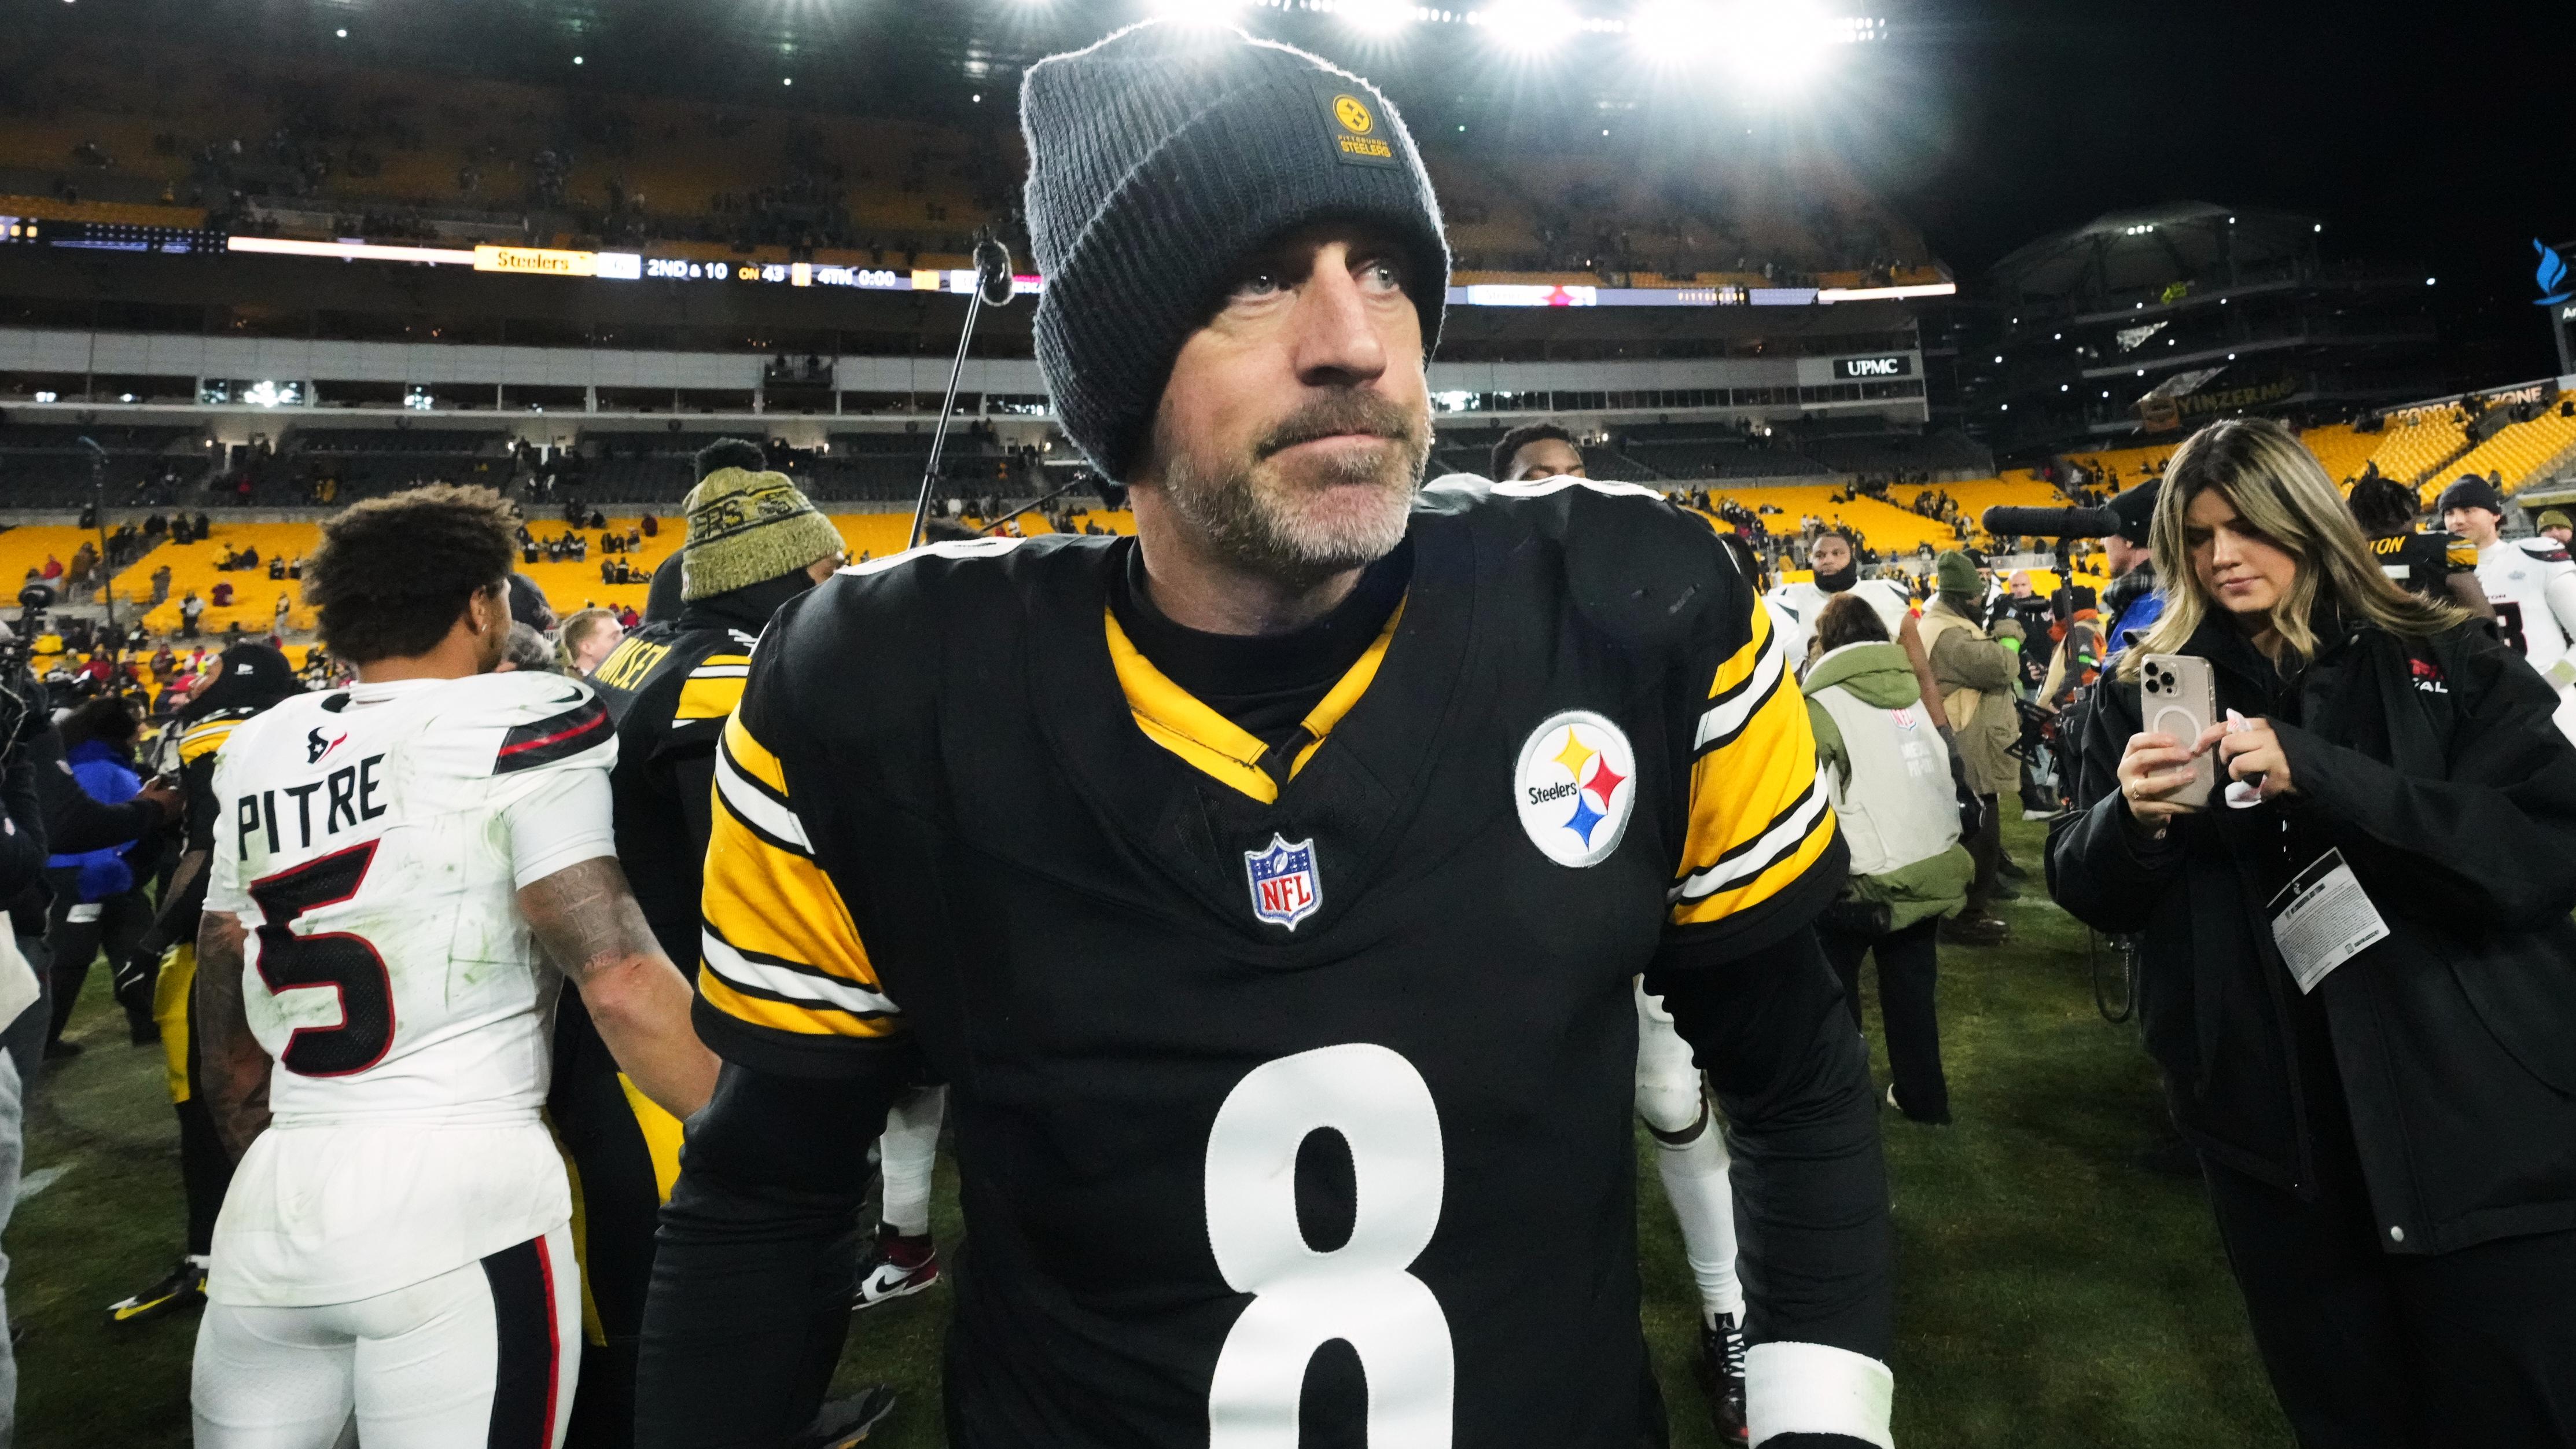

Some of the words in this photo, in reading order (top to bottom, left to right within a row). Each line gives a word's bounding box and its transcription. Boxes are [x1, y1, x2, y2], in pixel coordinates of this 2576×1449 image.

[1341, 140, 1392, 158] STEELERS
[498, 251, 569, 270] Steelers
[647, 259, 688, 277] 2ND
[705, 262, 728, 279] 10
[738, 267, 760, 280] ON
[761, 265, 785, 282] 43
[818, 267, 853, 285] 4TH
[858, 269, 896, 287] 0:00
[1848, 358, 1898, 376] UPMC
[2489, 385, 2543, 404] ZONE
[1528, 781, 1577, 805] Steelers
[238, 753, 388, 861] PITRE
[1260, 876, 1311, 911] NFL
[248, 837, 396, 1077] 5
[1204, 1042, 1455, 1449] 8
